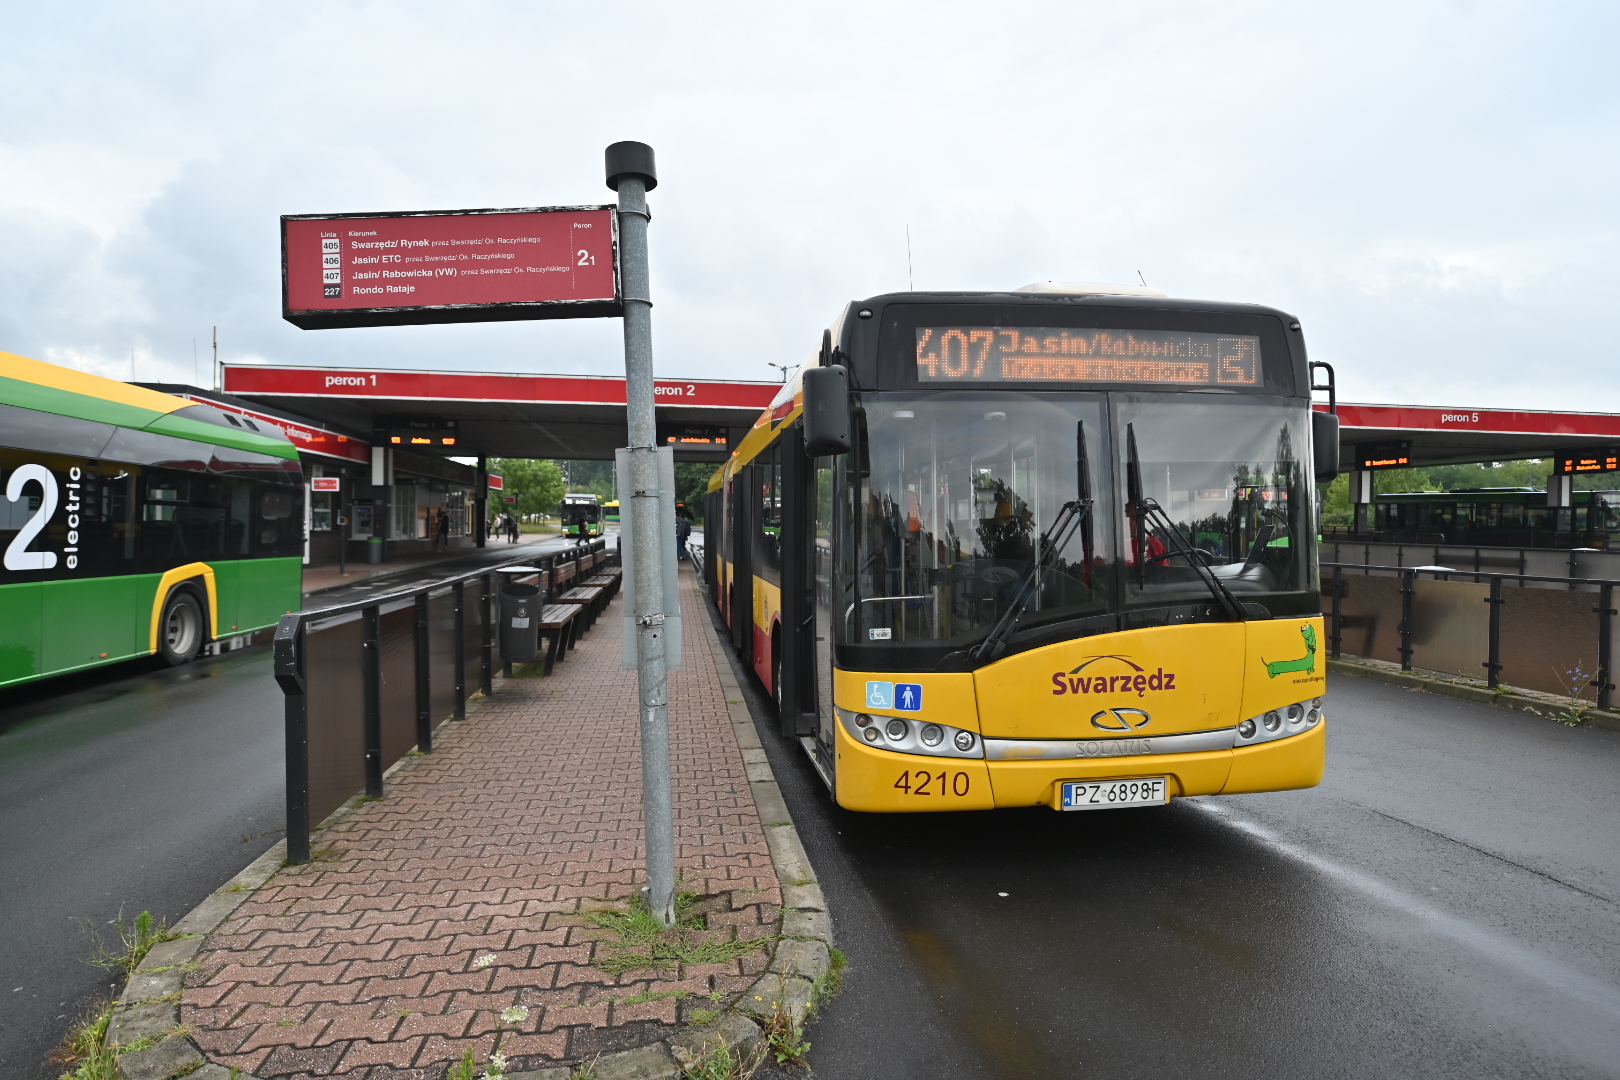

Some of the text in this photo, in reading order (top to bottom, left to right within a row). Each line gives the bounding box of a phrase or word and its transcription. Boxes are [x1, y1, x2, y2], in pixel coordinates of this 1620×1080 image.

[323, 242, 339, 250] 405
[351, 240, 398, 250] Swarzędz/
[401, 239, 430, 249] Rynek
[497, 236, 541, 245] Raczyńskiego
[324, 257, 339, 265] 406
[352, 255, 380, 265] Jasin/
[382, 255, 402, 263] ETC
[471, 252, 515, 261] Raczyńskiego
[324, 272, 340, 280] 407
[352, 271, 380, 280] Jasin/
[382, 269, 433, 278] Rabowicka
[435, 267, 458, 278] (VW)
[526, 265, 570, 274] Raczyńskiego
[324, 284, 416, 295] 227 Rondo Rataje
[916, 328, 994, 378] 407
[325, 374, 377, 388] peron 1
[654, 384, 696, 396] eron 2
[1441, 412, 1479, 424] peron 5
[4, 463, 59, 571] 2
[64, 467, 81, 569] electric
[1051, 667, 1176, 698] Swarzędz
[1075, 740, 1152, 757] SOLARIS
[893, 770, 970, 797] 4210
[1075, 785, 1101, 804] PZ
[1107, 781, 1163, 803] 6898F
